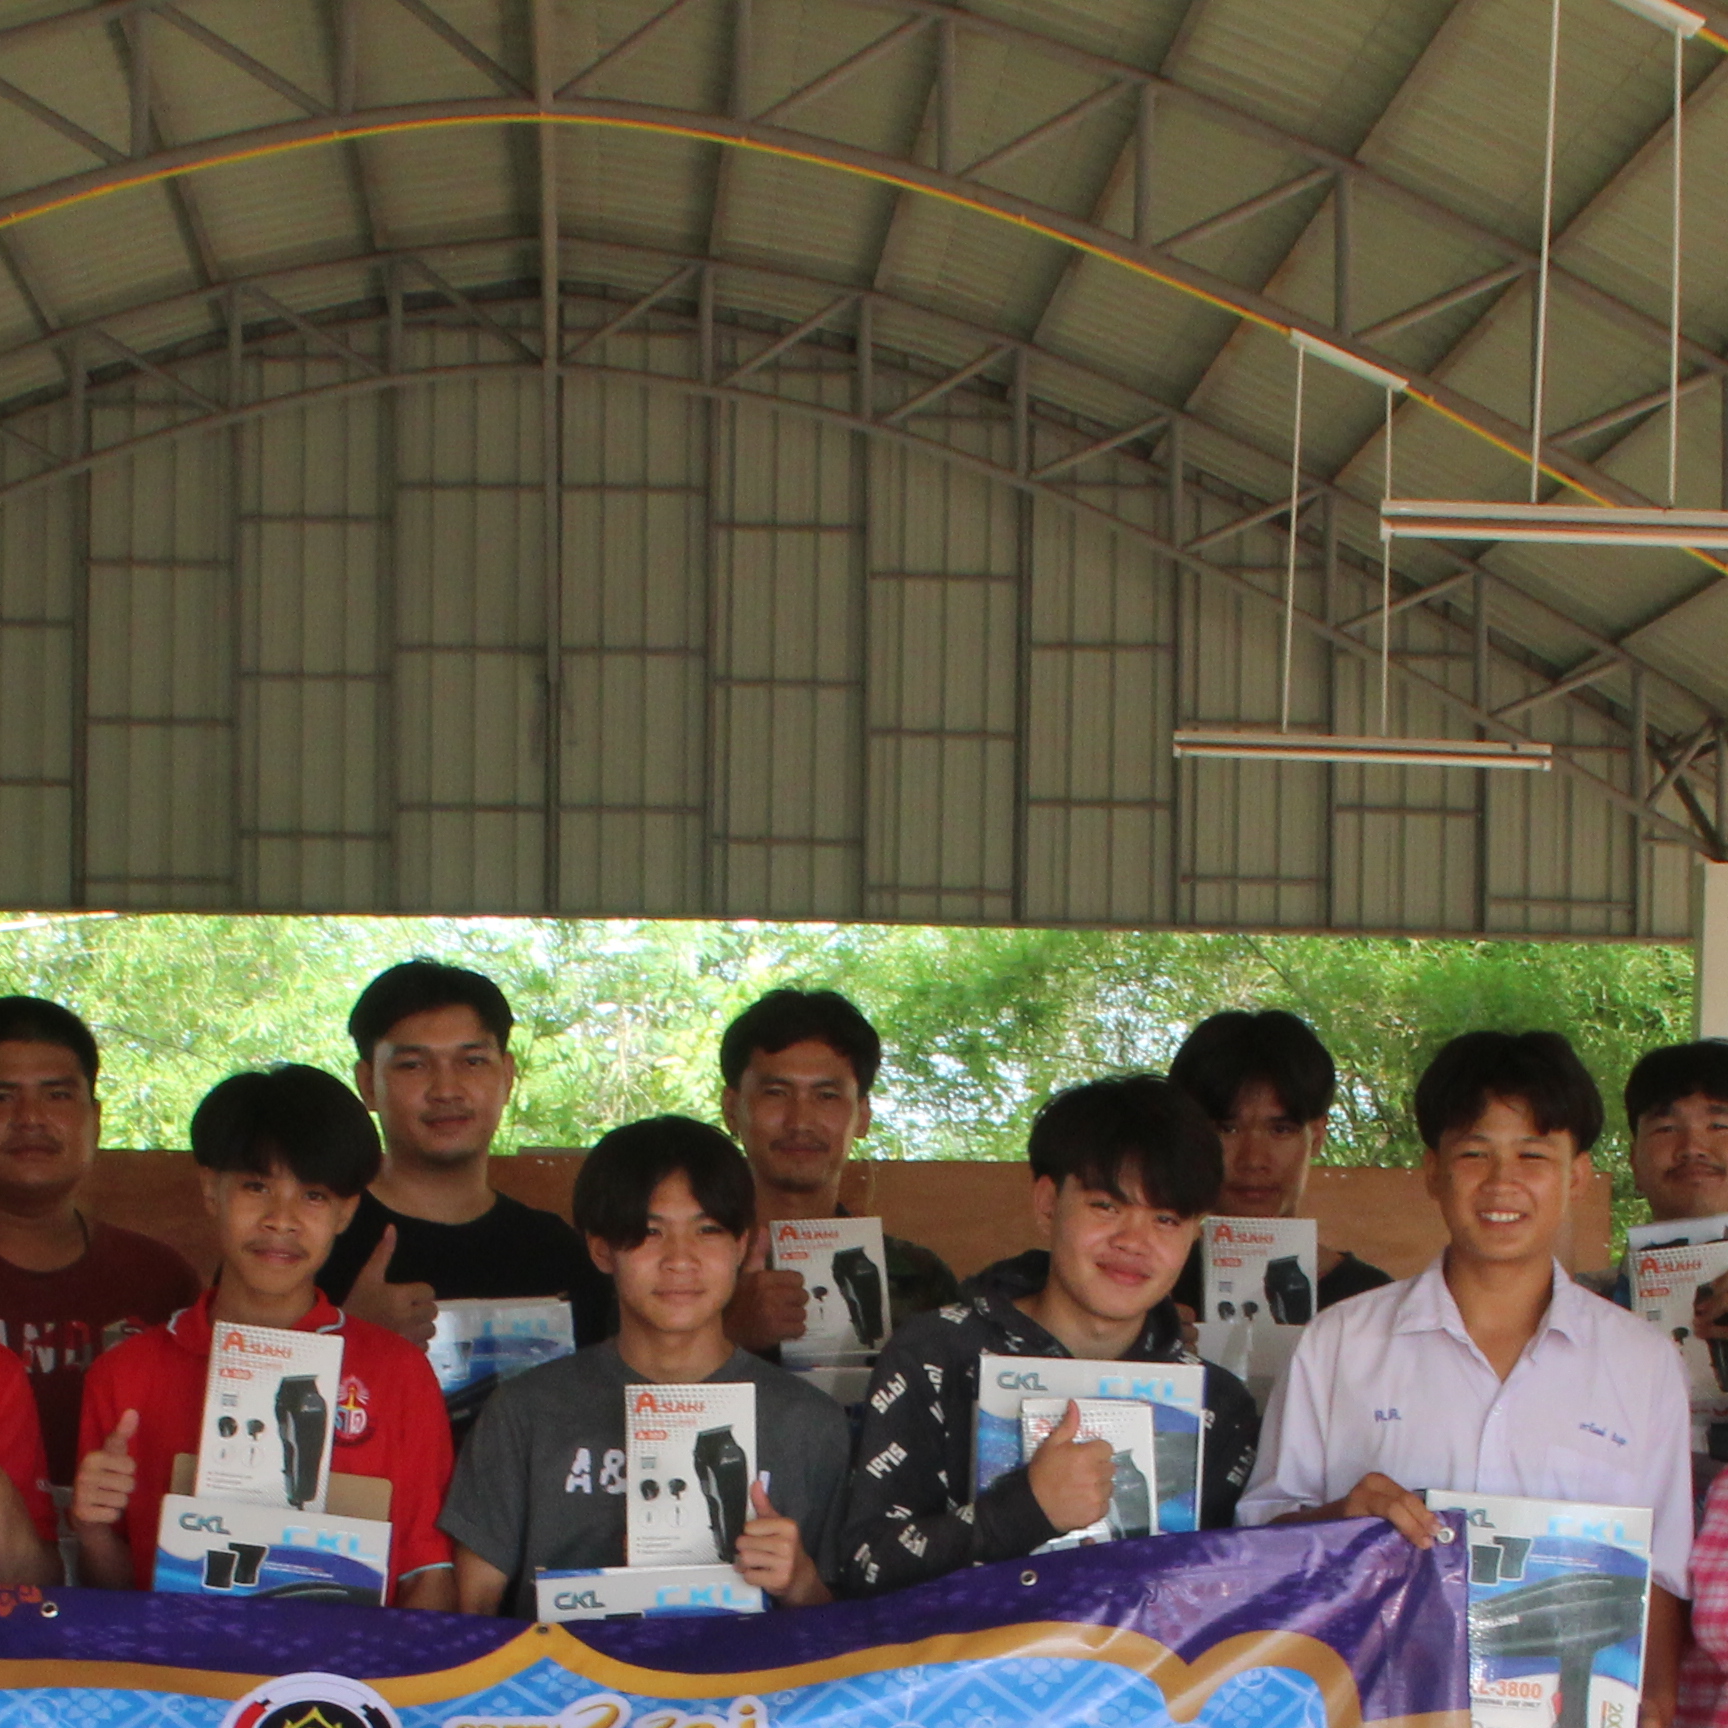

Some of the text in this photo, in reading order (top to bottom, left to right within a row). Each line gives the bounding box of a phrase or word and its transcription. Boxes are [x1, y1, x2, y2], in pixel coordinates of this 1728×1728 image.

[996, 1370, 1049, 1391] CKL
[180, 1512, 231, 1535] CKL
[555, 1591, 605, 1610] CKL
